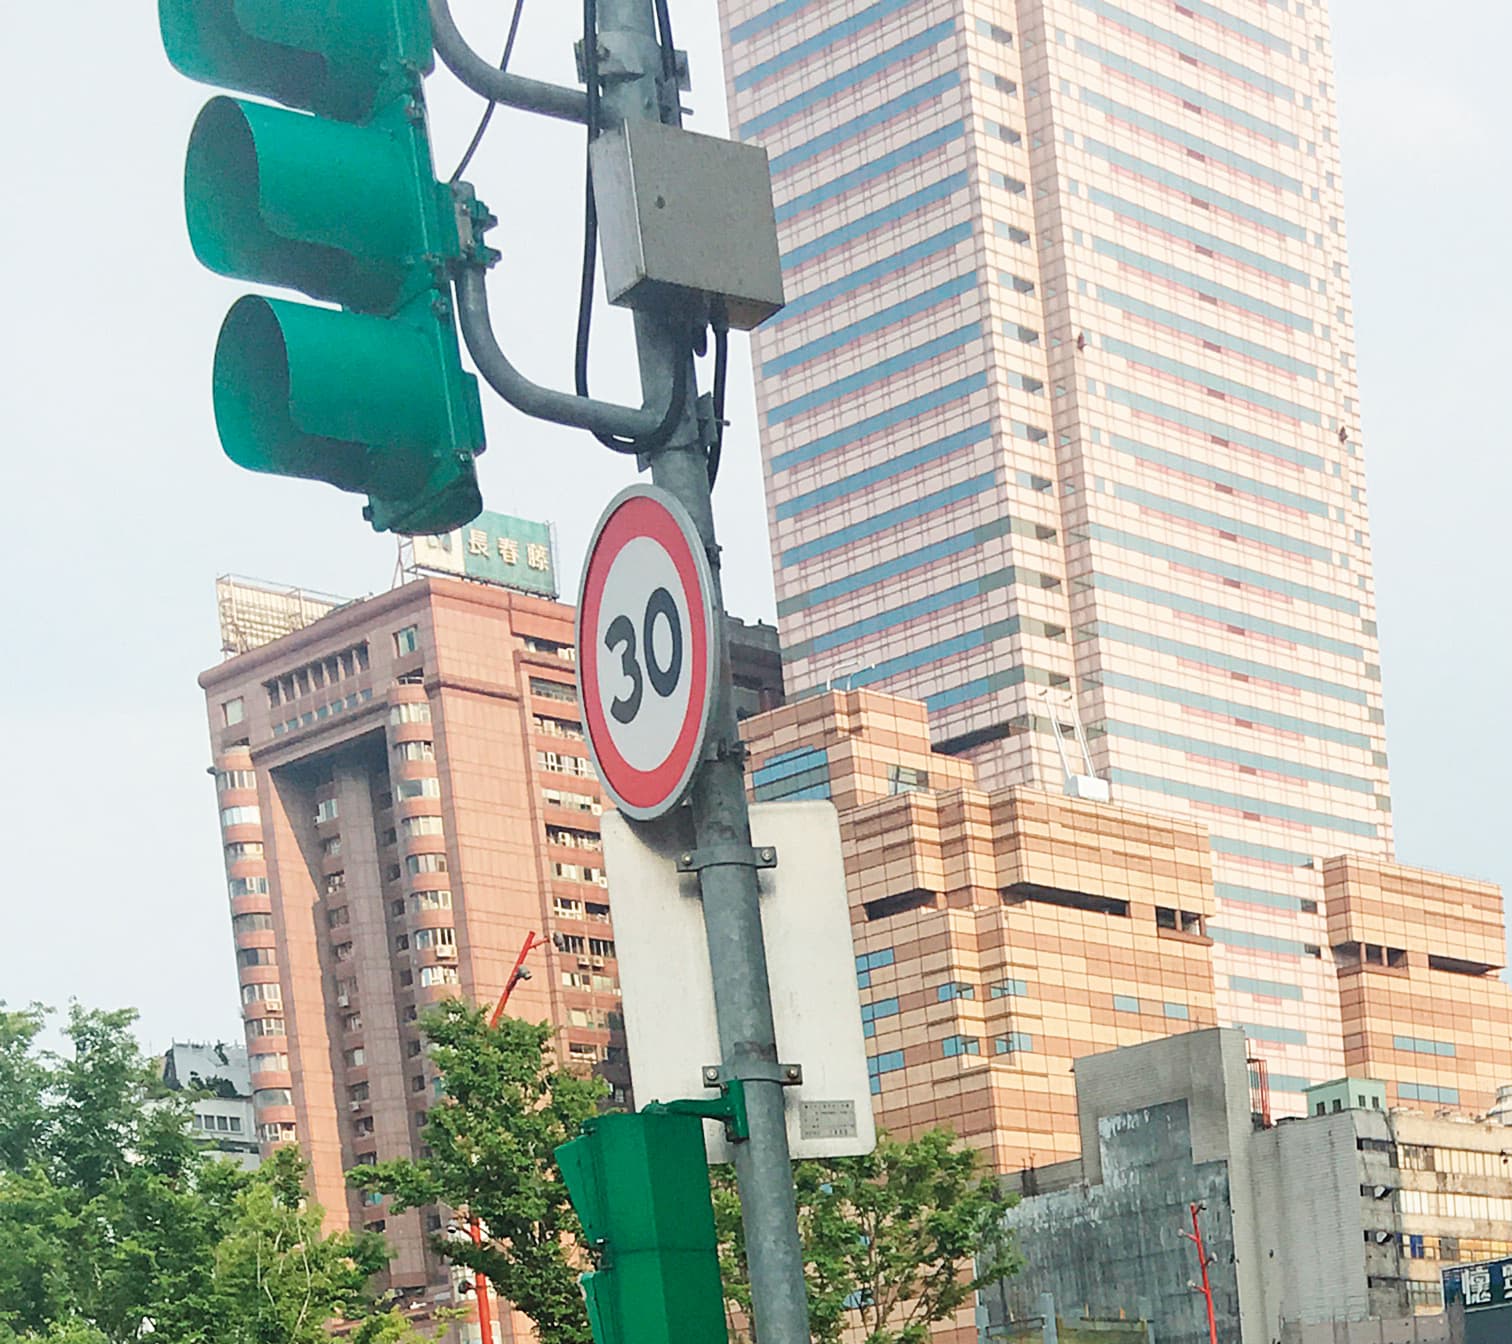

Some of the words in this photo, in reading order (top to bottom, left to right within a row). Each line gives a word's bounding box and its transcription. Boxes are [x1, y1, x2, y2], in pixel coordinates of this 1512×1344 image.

[468, 528, 549, 572] 長春藤
[604, 586, 683, 725] 30
